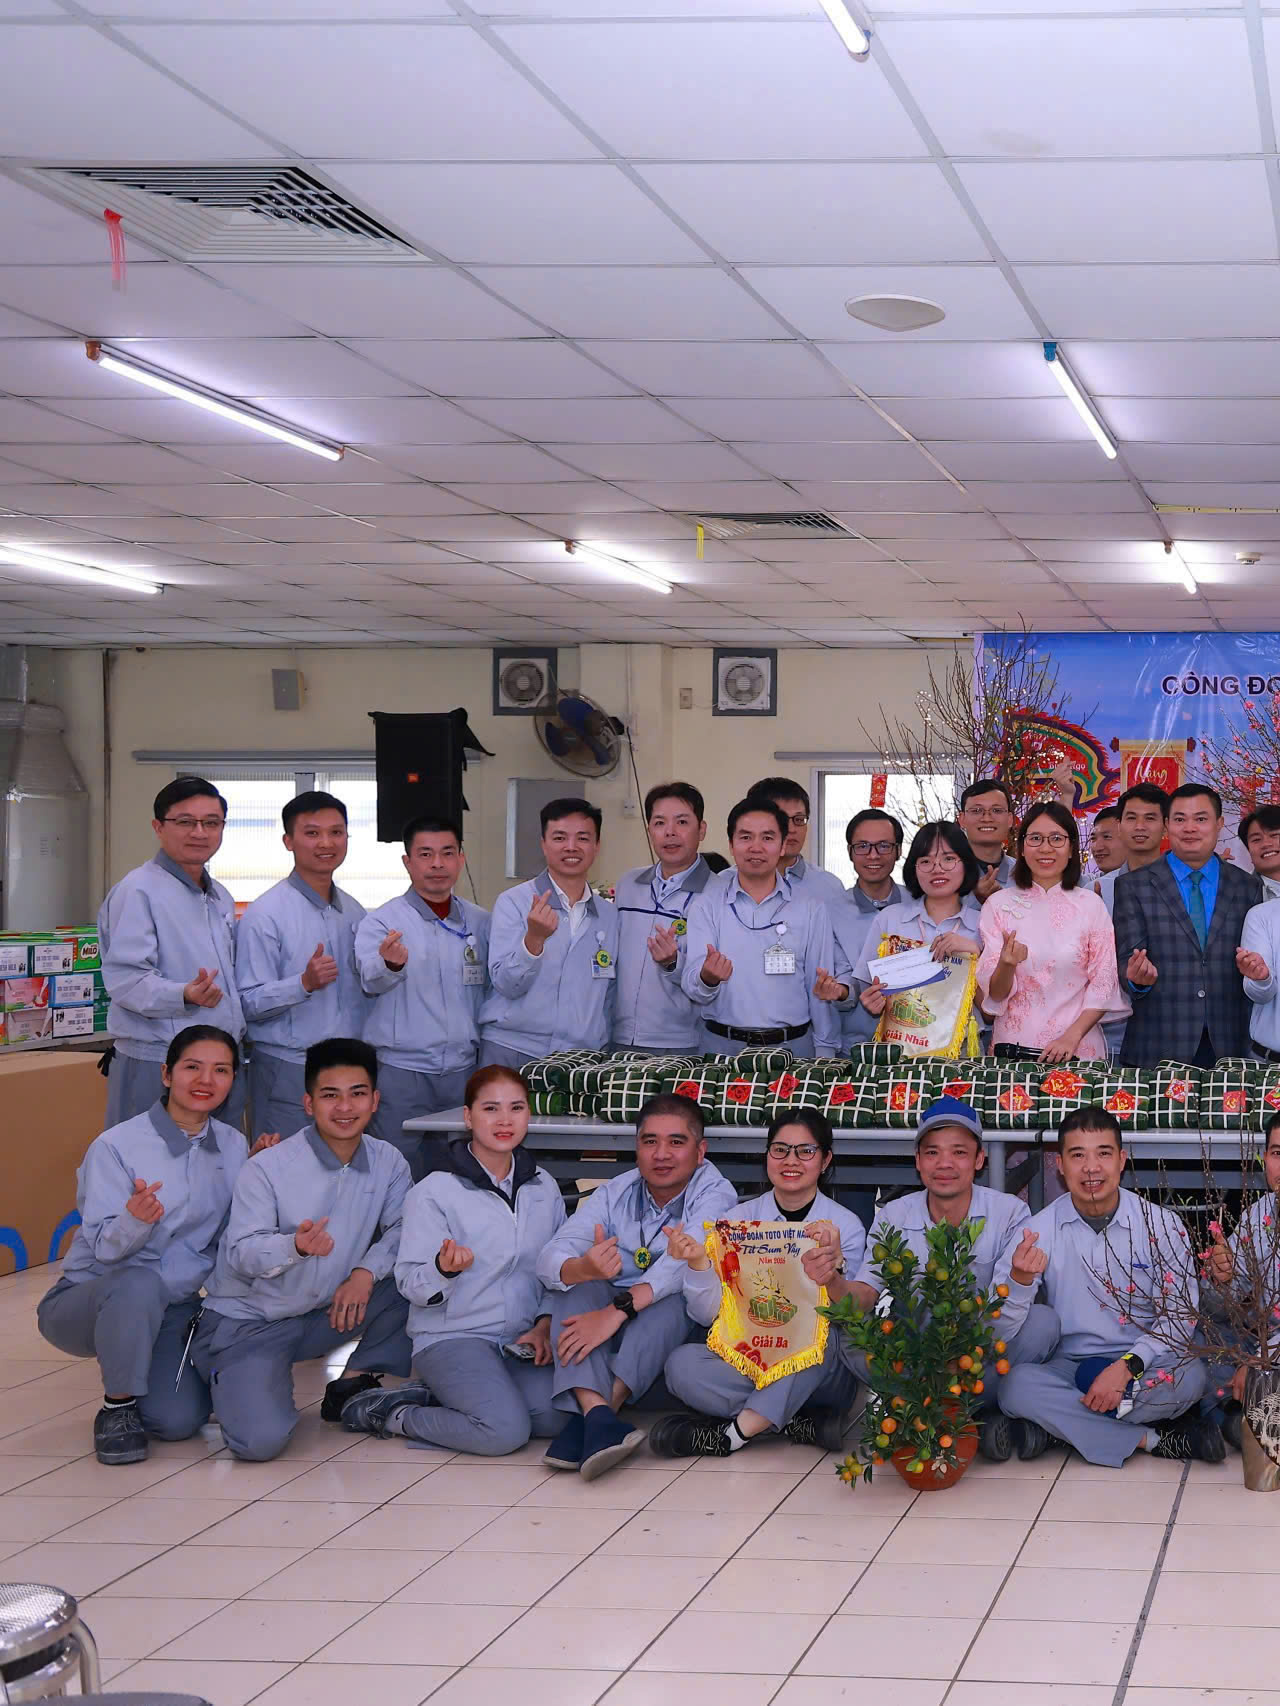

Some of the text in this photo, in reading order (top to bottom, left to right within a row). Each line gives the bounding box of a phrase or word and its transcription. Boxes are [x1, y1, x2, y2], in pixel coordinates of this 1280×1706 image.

[1162, 671, 1239, 695] CÔNG
[886, 1029, 929, 1047] Giải Nhất
[747, 1230, 763, 1241] ĐOÀN
[765, 1230, 781, 1241] TOTO
[783, 1228, 796, 1241] VIỆT
[757, 1243, 782, 1255] Sum
[758, 1256, 773, 1266] Năm
[752, 1335, 788, 1349] Giải Ba
